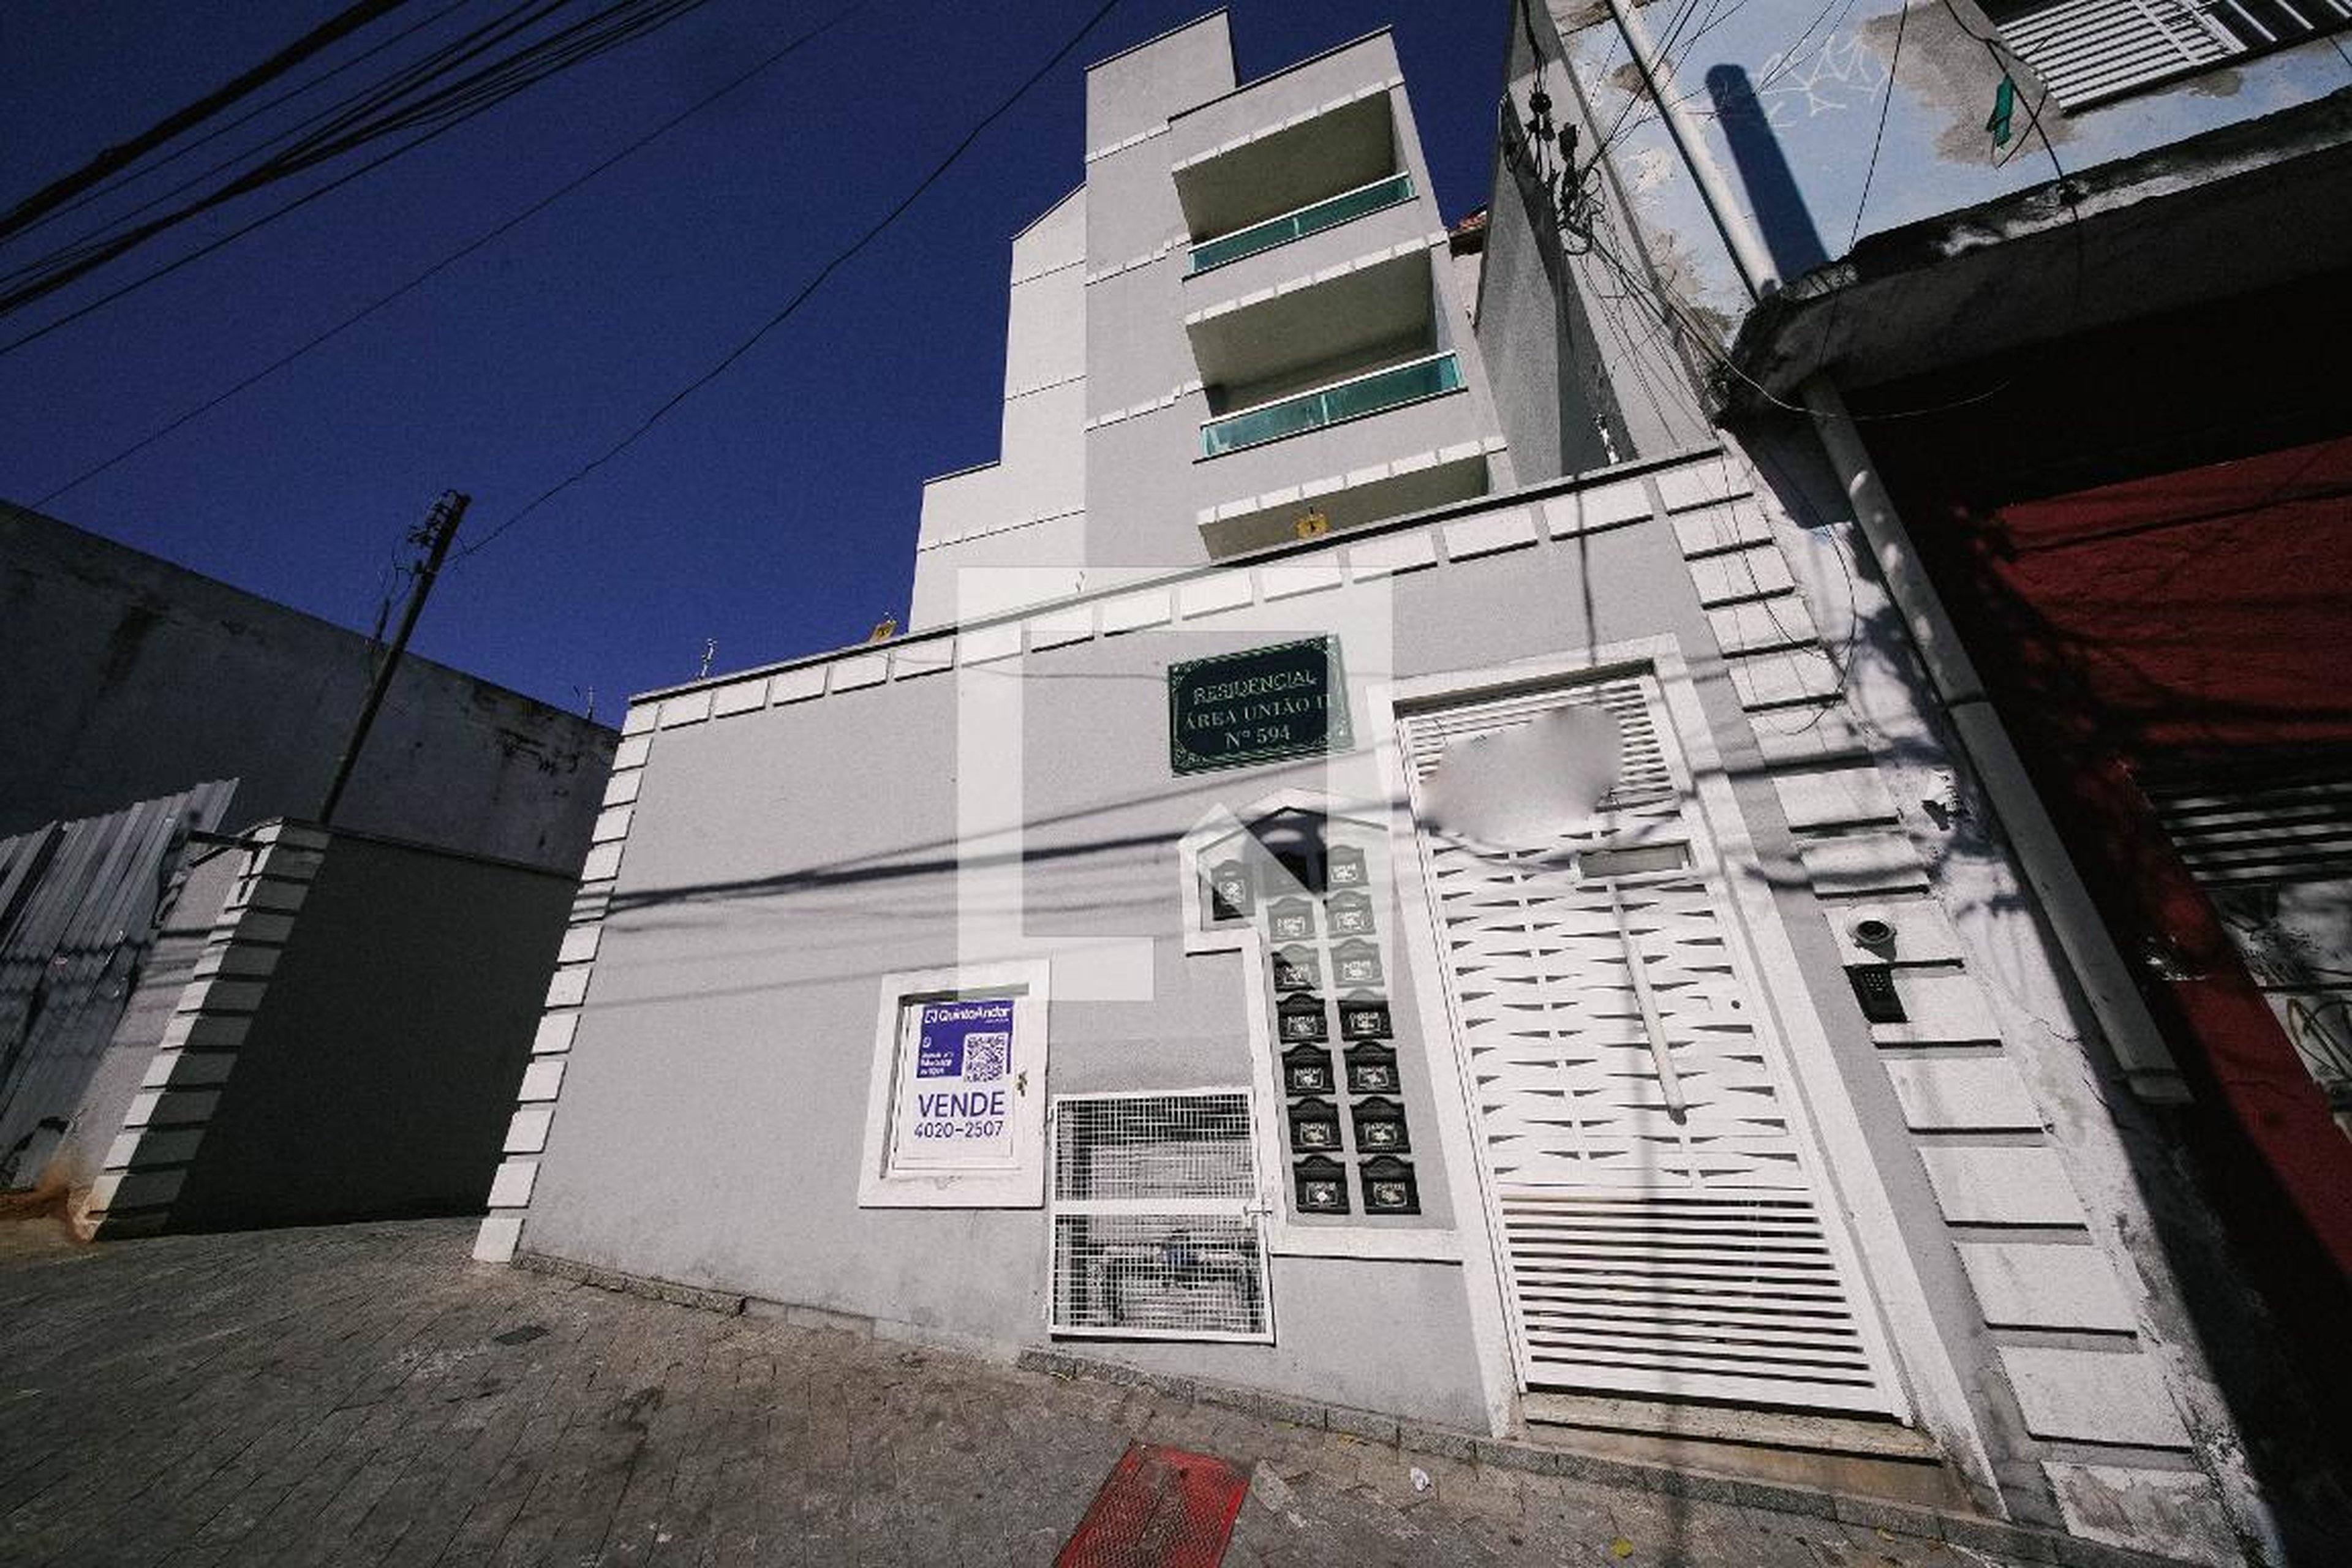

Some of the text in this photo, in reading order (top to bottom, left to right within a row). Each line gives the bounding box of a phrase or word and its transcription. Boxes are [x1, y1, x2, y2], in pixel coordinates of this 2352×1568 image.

[1193, 669, 1317, 704] RESIDENCIAL
[1185, 708, 1237, 729] ÁREA
[1245, 696, 1309, 722] UNIÃO
[1256, 725, 1291, 743] 594
[939, 1006, 1010, 1021] QuintoAndar
[918, 1090, 1005, 1117] VENDE
[914, 1120, 1004, 1139] 4020-2507
